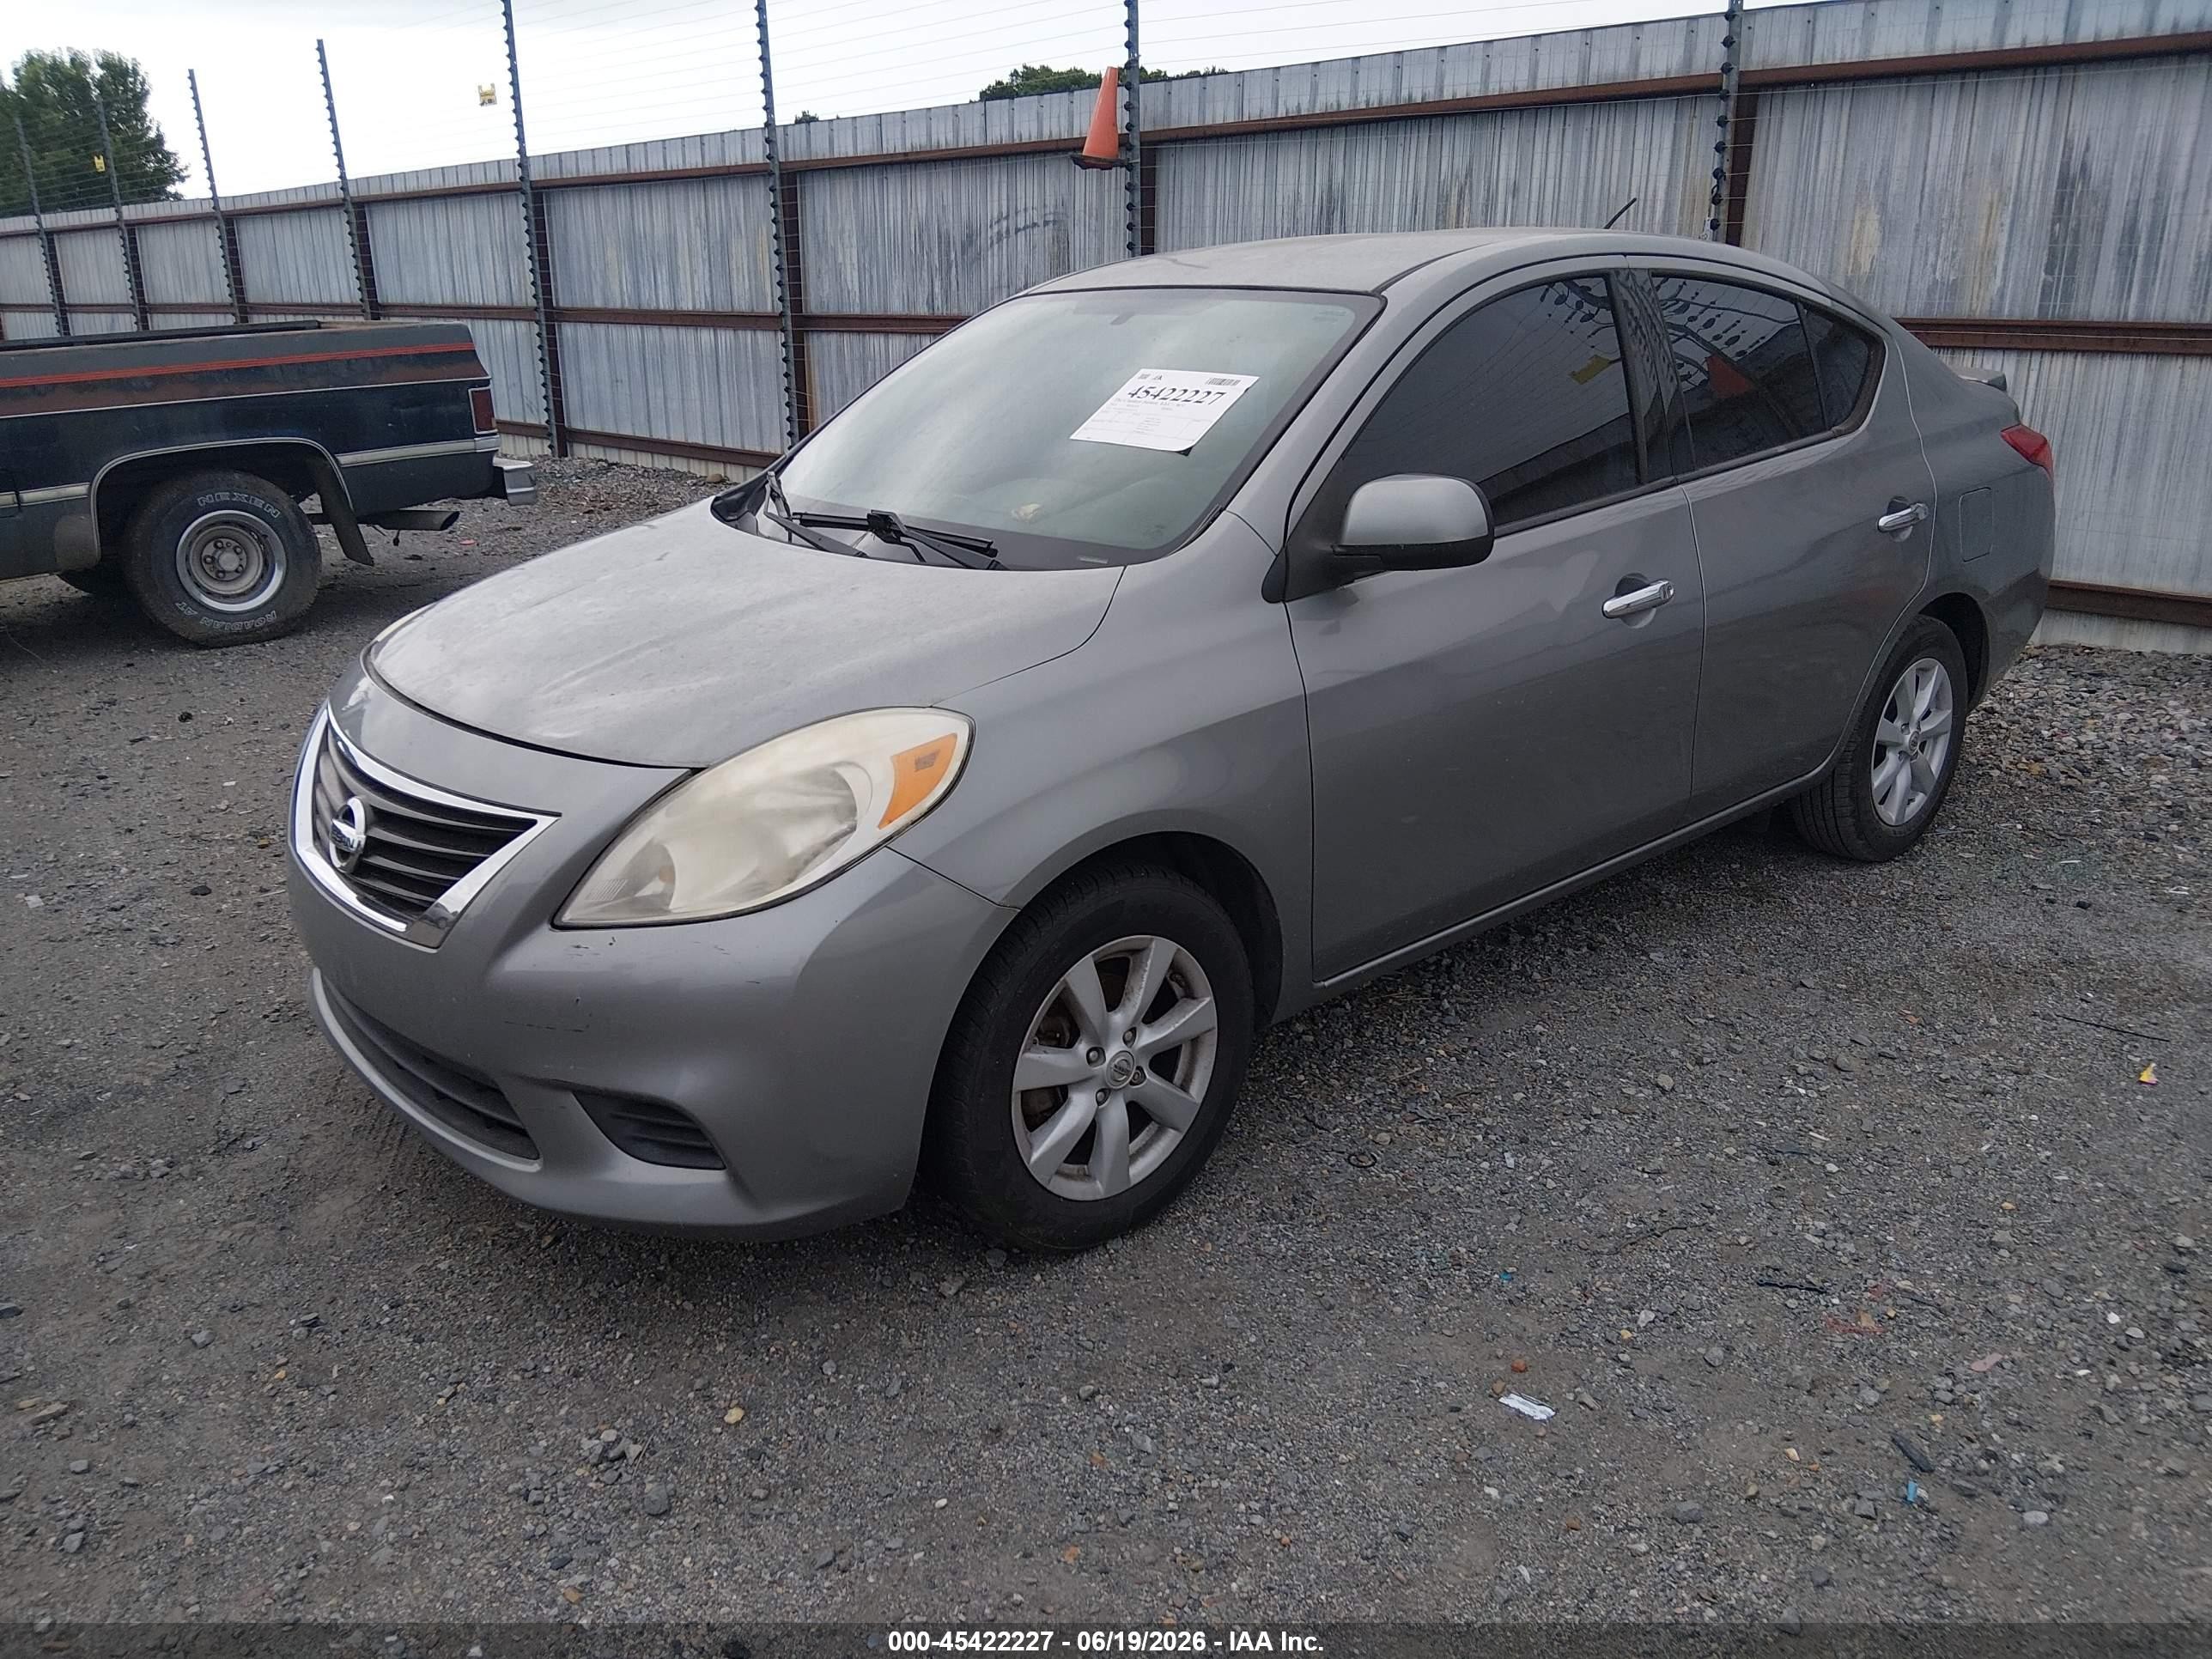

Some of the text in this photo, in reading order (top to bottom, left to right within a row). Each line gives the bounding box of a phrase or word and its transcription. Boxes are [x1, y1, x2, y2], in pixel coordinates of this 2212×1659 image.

[1127, 385, 1227, 405] 45422227
[197, 491, 281, 519] NEXEN
[174, 601, 277, 632] ROADIAN AT
